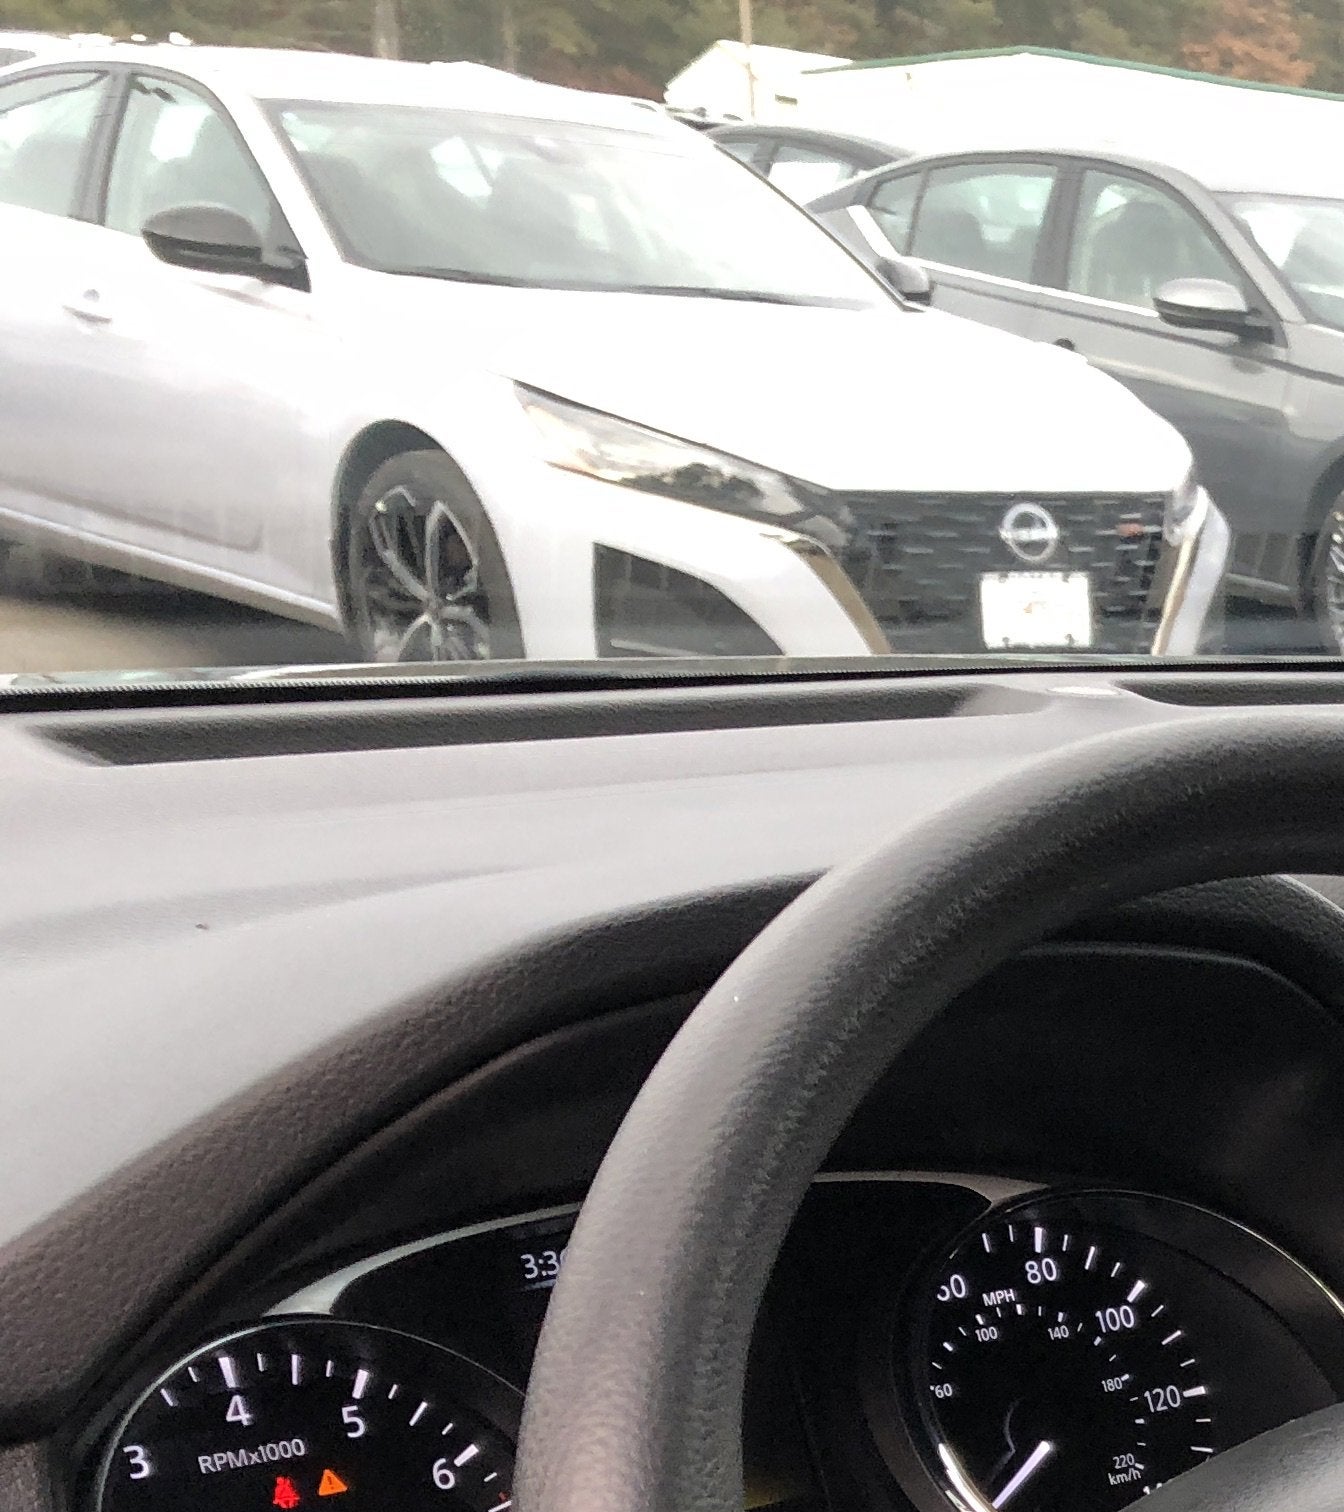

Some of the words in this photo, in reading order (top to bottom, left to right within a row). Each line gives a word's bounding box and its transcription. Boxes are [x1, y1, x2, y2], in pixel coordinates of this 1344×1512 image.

[520, 1250, 567, 1279] 3:3
[1025, 1258, 1057, 1284] 80
[982, 1289, 1016, 1307] MPH
[1095, 1305, 1135, 1333] 100
[975, 1326, 998, 1342] 100
[1048, 1325, 1070, 1341] 140
[934, 1383, 953, 1399] 60
[1101, 1377, 1123, 1393] 180
[225, 1394, 251, 1426] 4
[1143, 1385, 1181, 1413] 120
[341, 1405, 366, 1438] 5
[122, 1445, 151, 1480] 3
[432, 1457, 456, 1490] 6
[1112, 1452, 1135, 1470] 220
[1107, 1467, 1142, 1486] km/h
